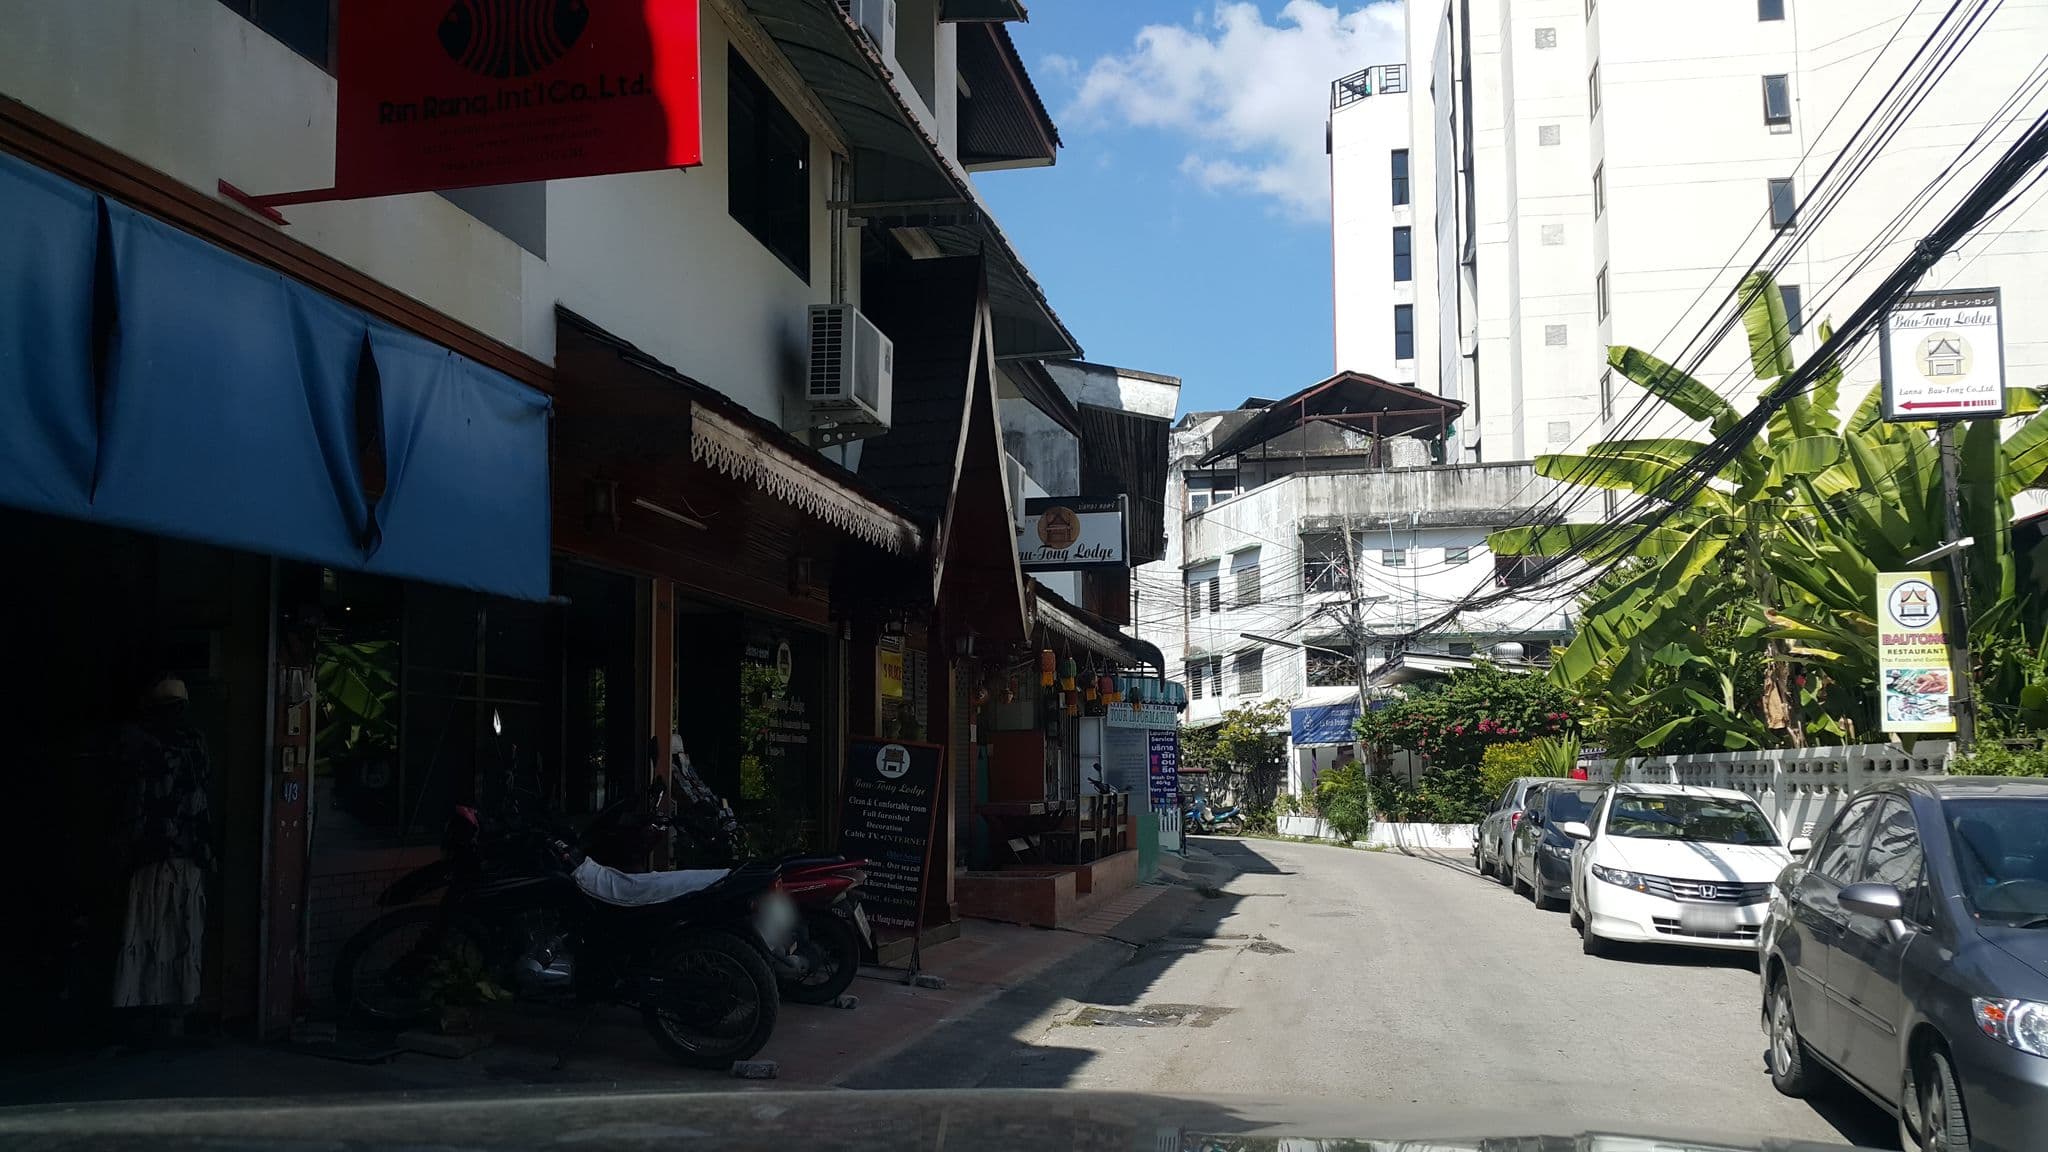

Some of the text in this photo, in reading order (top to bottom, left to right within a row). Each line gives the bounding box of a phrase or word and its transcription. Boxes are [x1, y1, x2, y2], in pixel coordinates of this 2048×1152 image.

[1954, 310, 1993, 327] Lodge
[1899, 387, 1922, 396] Lanna
[1073, 543, 1114, 562] Lodge
[1111, 708, 1128, 722] TOUR
[898, 784, 927, 797] Lodge
[849, 796, 866, 806] Clean
[873, 798, 910, 811] Comfortable
[911, 805, 927, 813] room
[862, 809, 910, 822] Full furnished
[866, 821, 903, 832] Decoration
[845, 829, 866, 838] Cable
